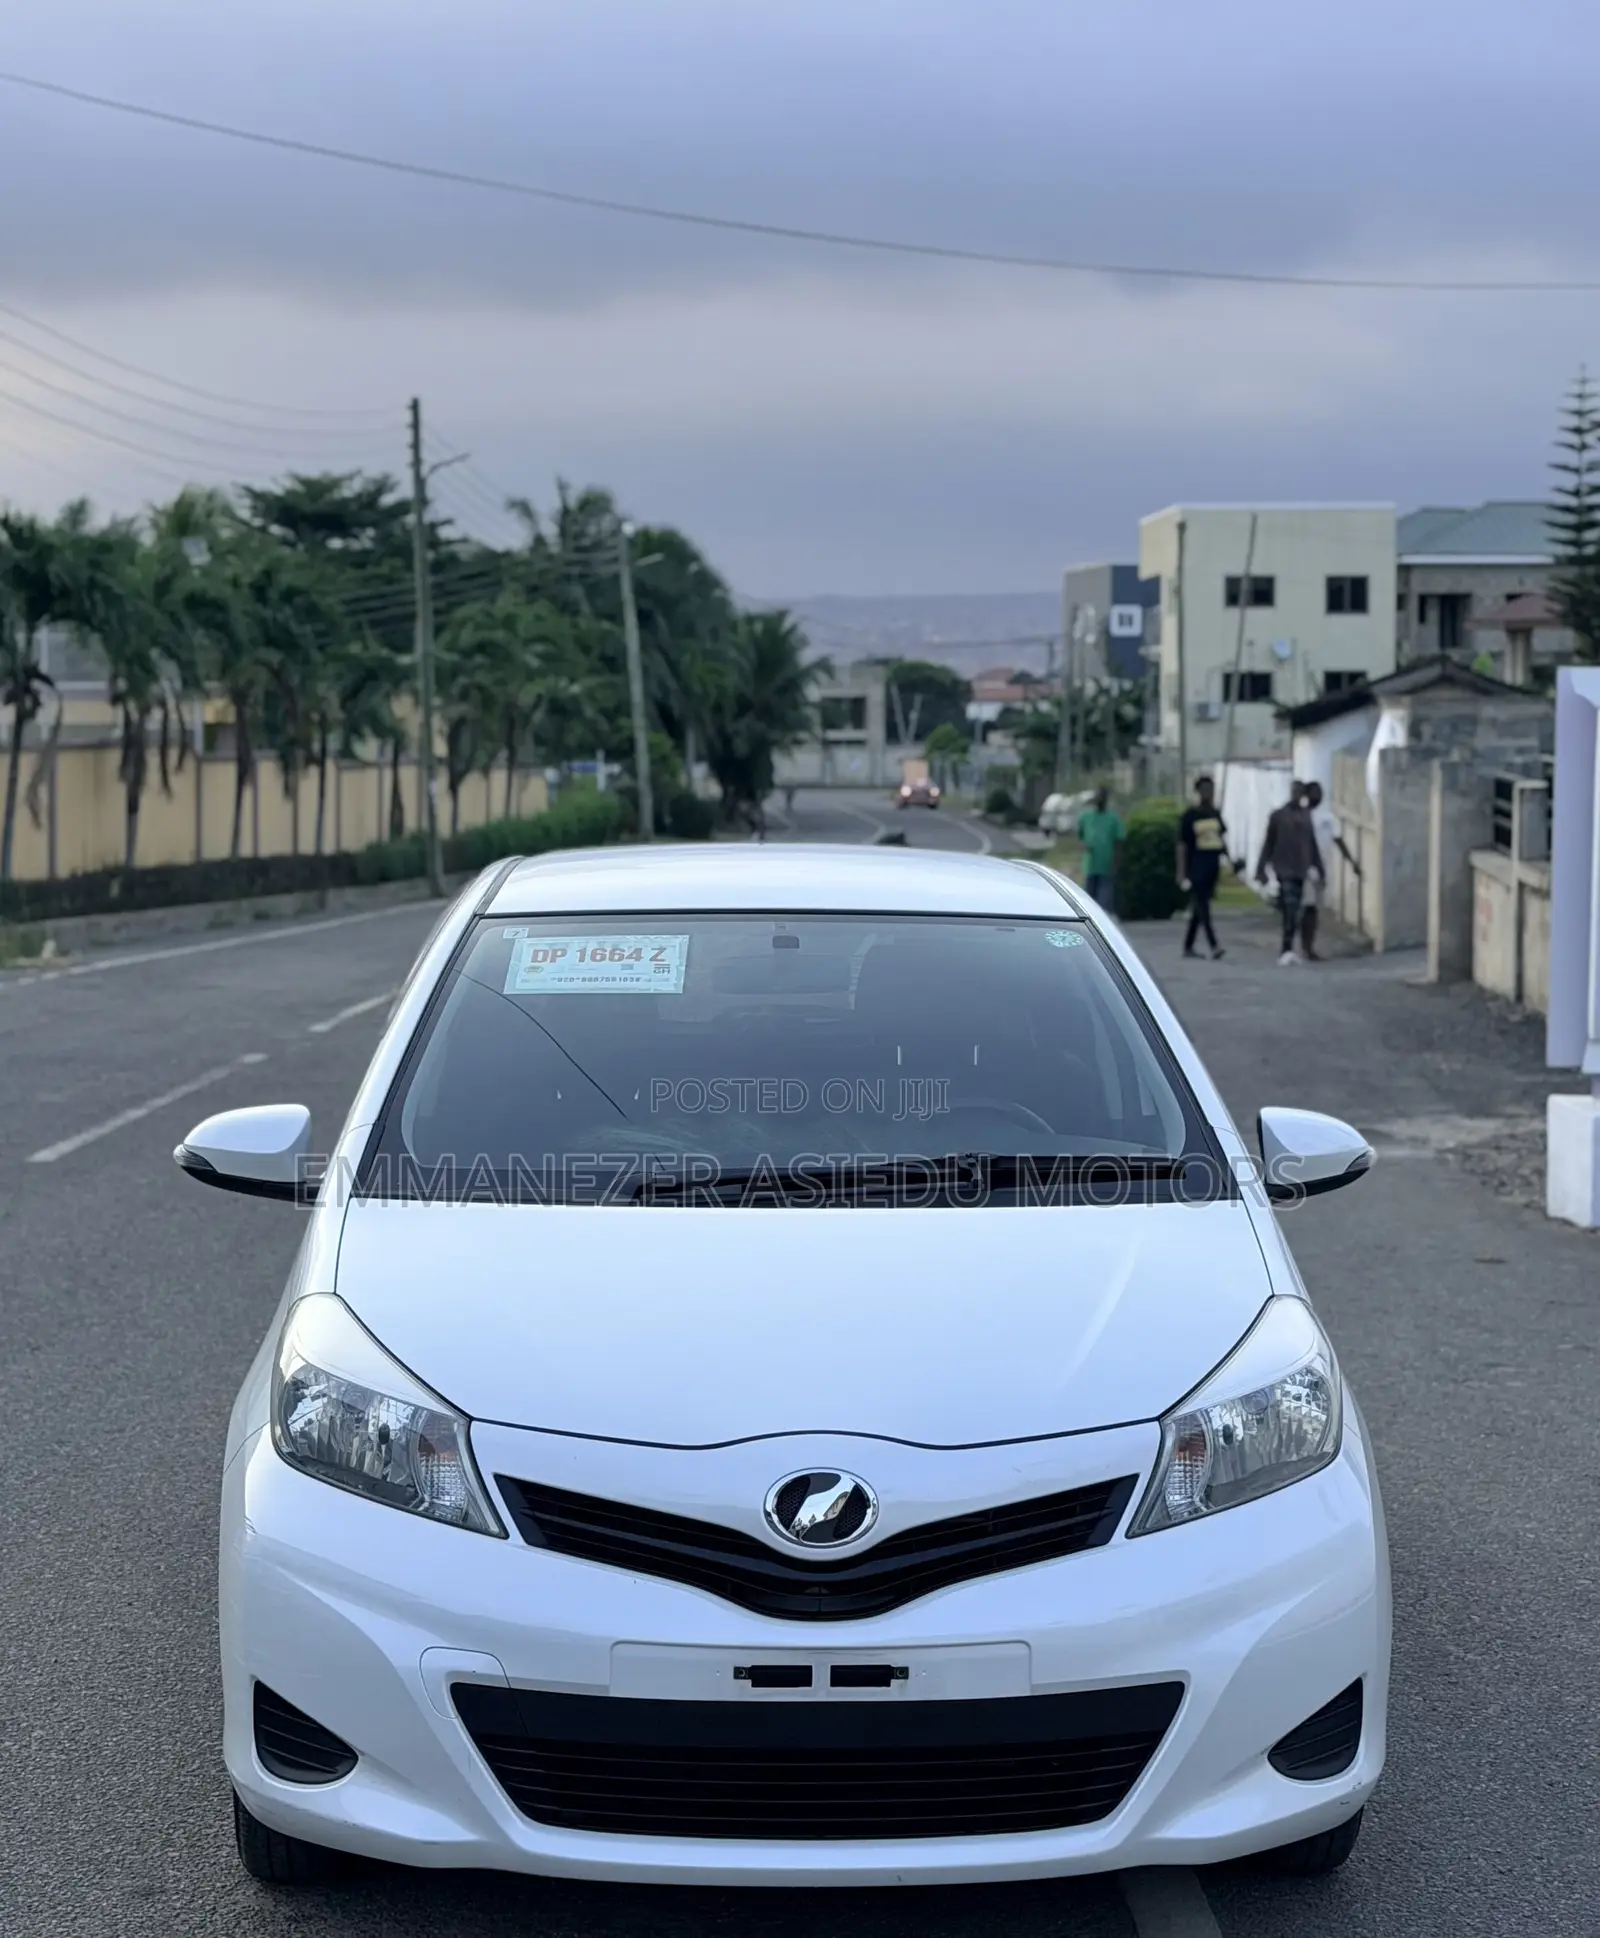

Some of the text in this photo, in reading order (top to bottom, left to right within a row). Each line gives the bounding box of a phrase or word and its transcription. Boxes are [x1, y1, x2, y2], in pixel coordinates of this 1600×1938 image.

[530, 946, 668, 964] DP 1664 Z
